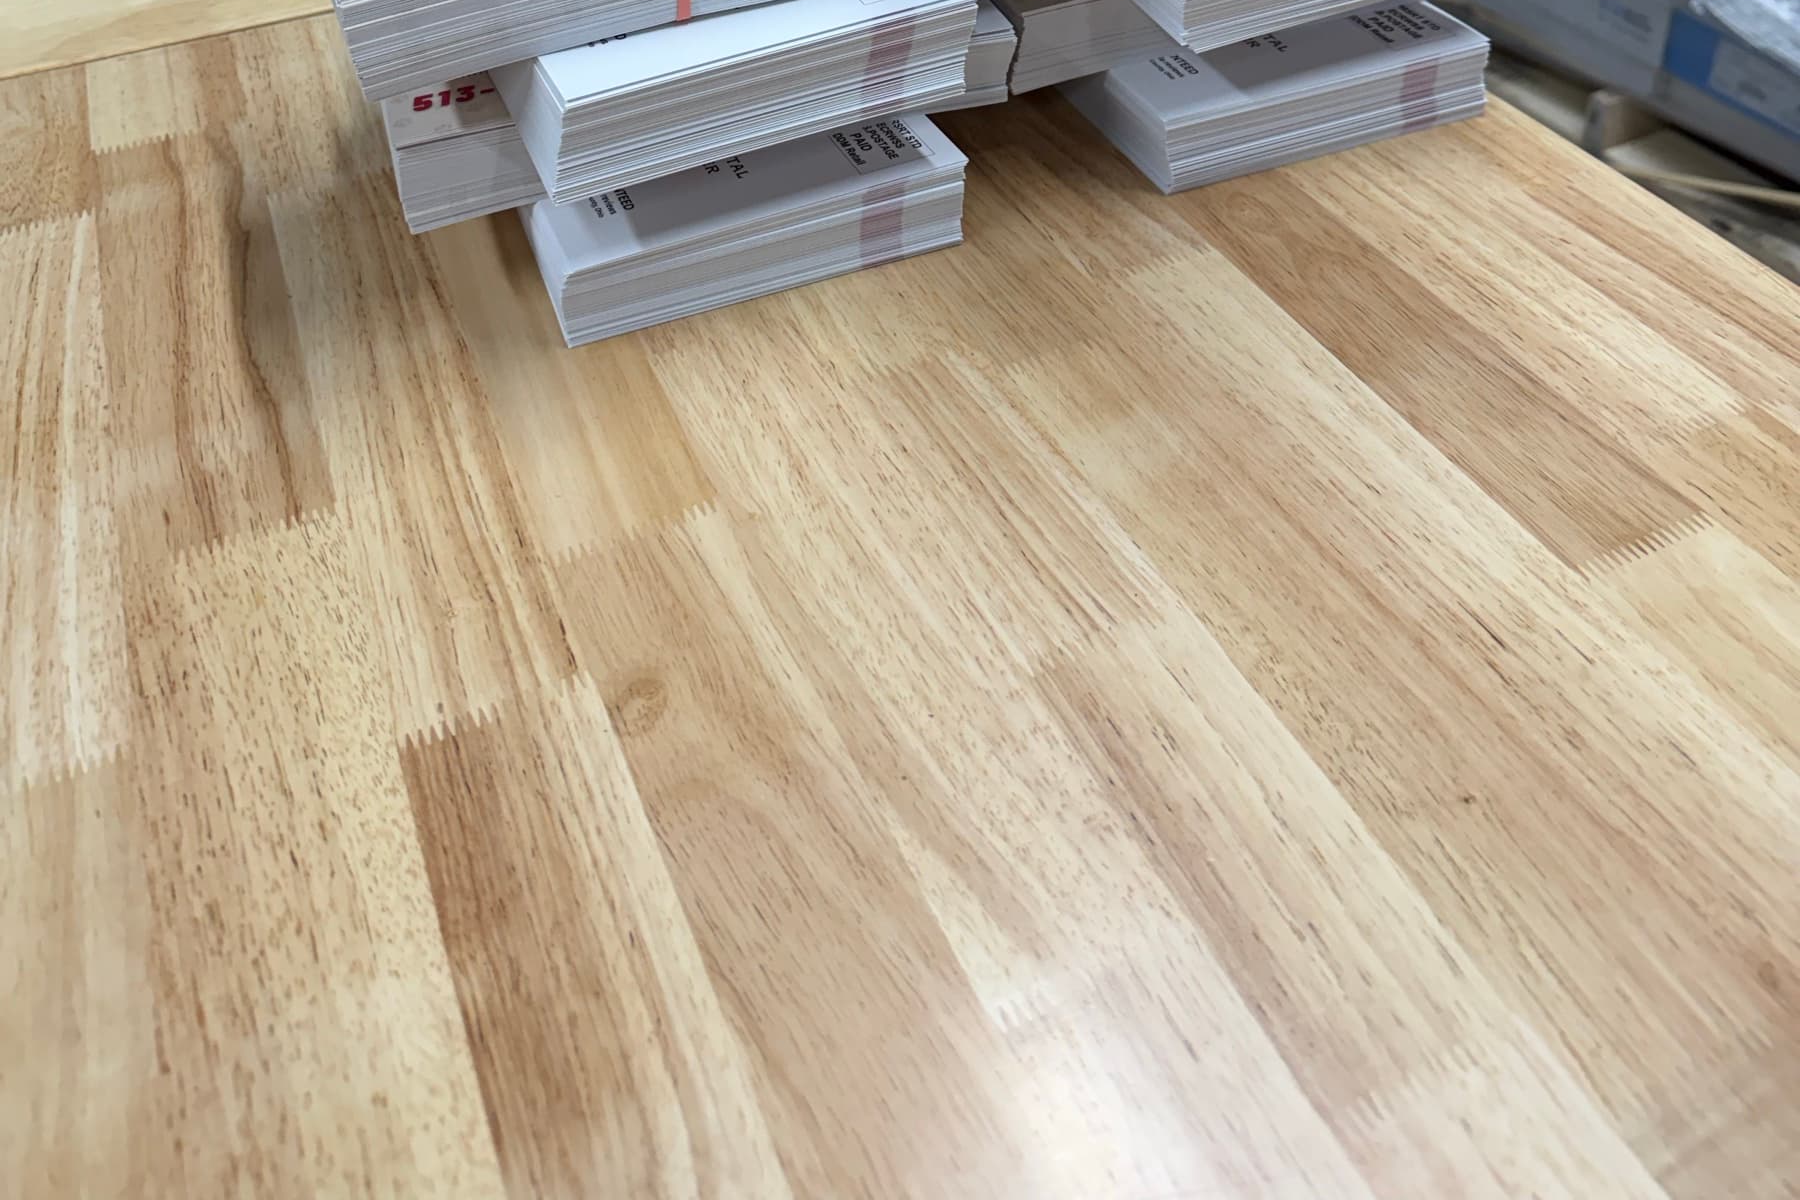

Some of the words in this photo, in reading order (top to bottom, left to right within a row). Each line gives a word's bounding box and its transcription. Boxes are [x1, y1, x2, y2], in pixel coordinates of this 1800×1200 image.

[849, 132, 873, 151] PAID
[905, 134, 923, 149] STD
[845, 147, 867, 166] Retail
